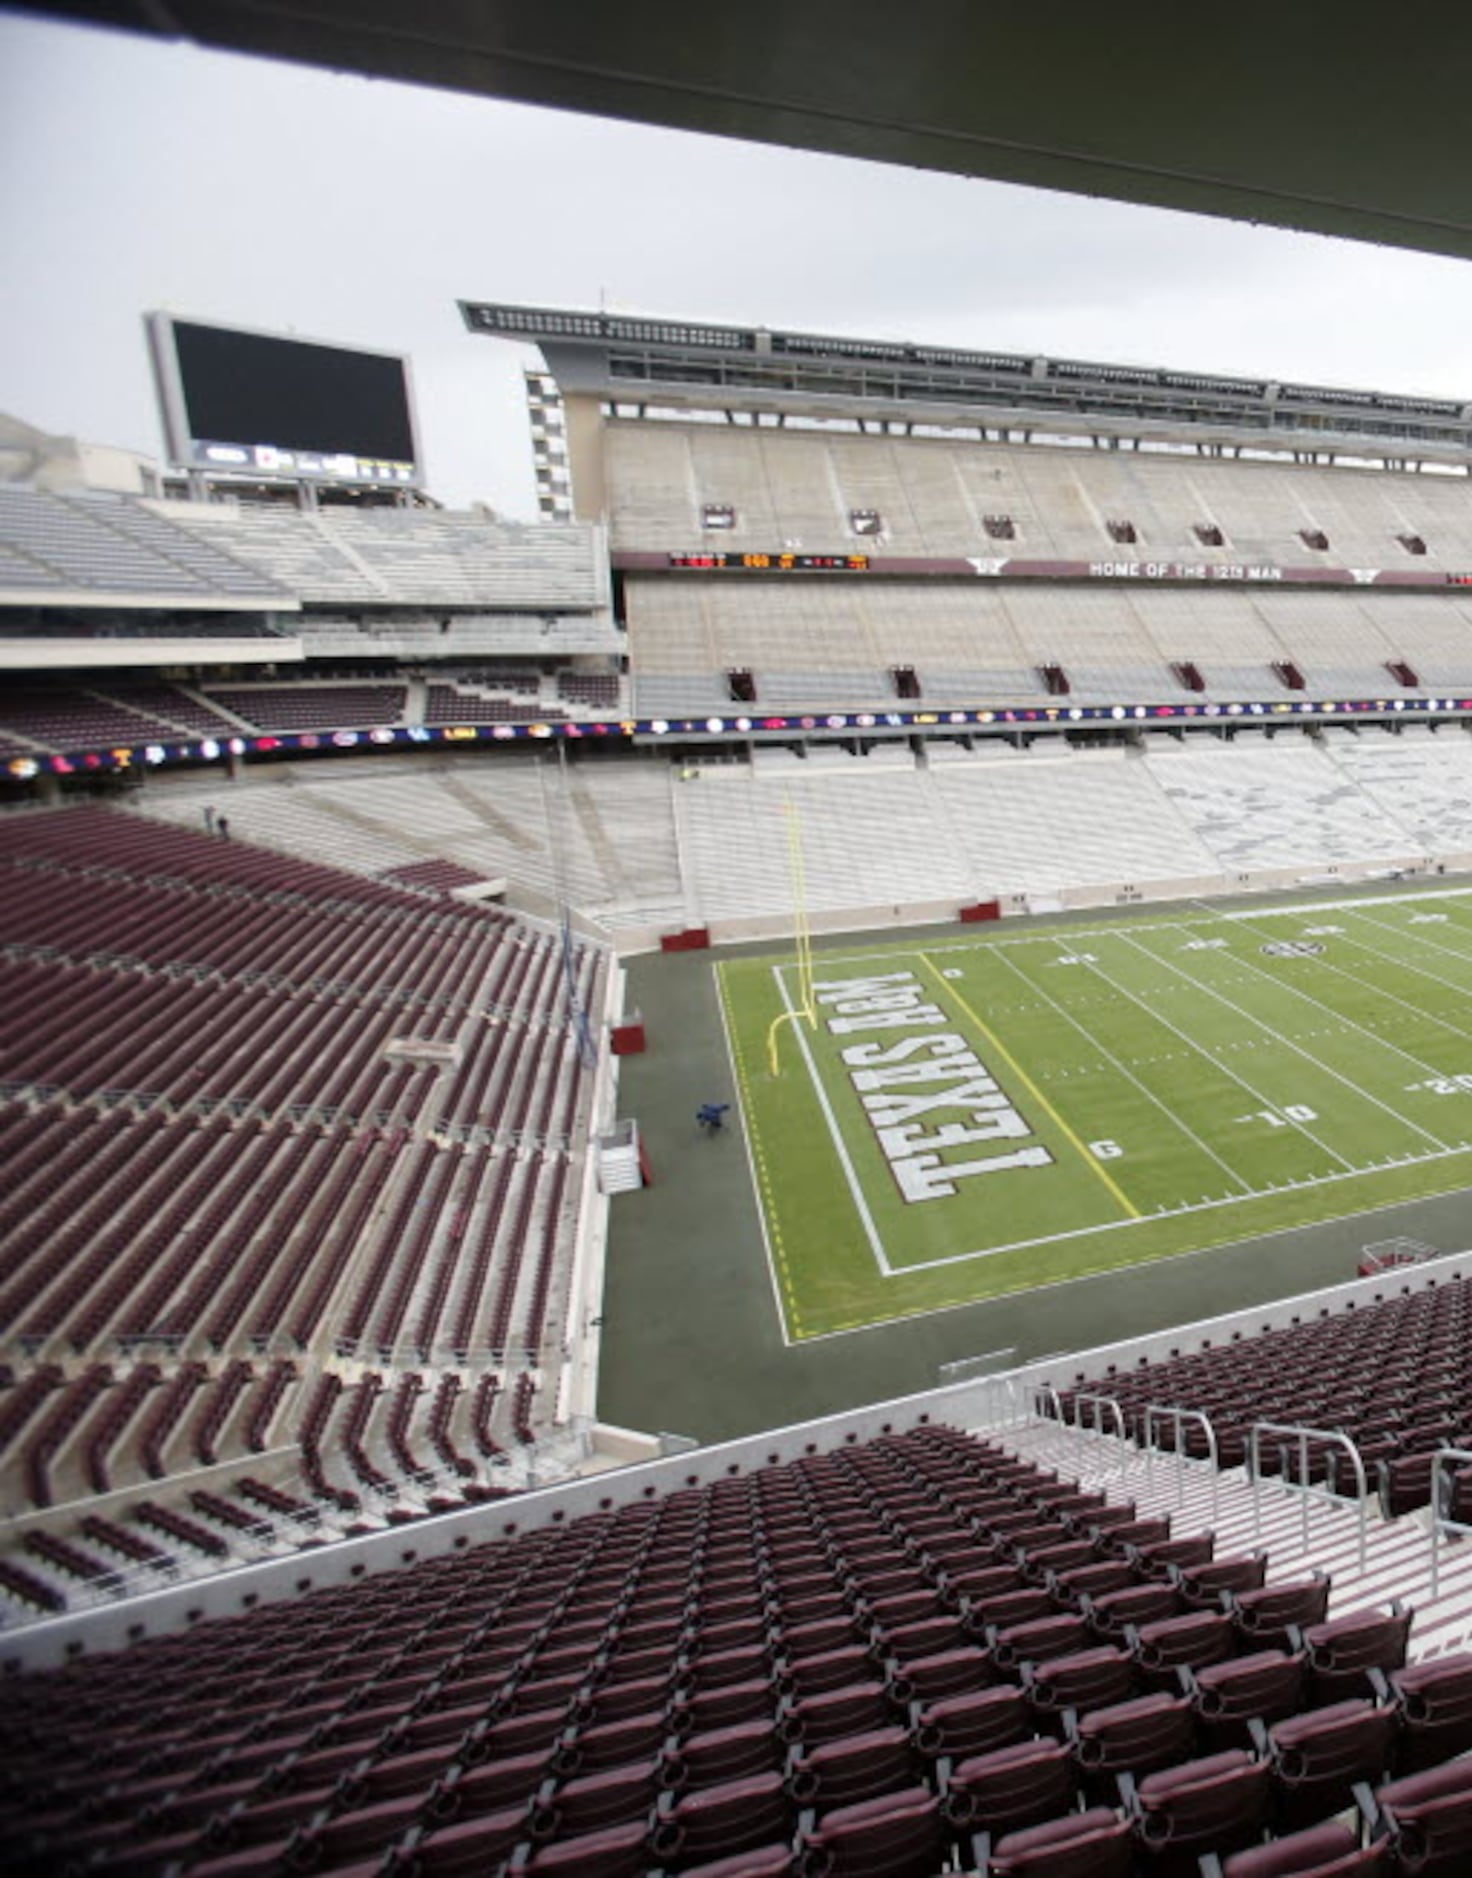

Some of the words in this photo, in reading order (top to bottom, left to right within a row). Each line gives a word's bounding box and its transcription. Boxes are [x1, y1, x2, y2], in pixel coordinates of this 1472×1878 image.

[1089, 562, 1140, 577] HOME
[1146, 562, 1170, 577] OF
[1175, 564, 1206, 578] THE
[1247, 566, 1282, 579] MAN
[811, 971, 951, 1035] A&M
[839, 1032, 1056, 1204] TEXAS
[1256, 1103, 1319, 1127] 10
